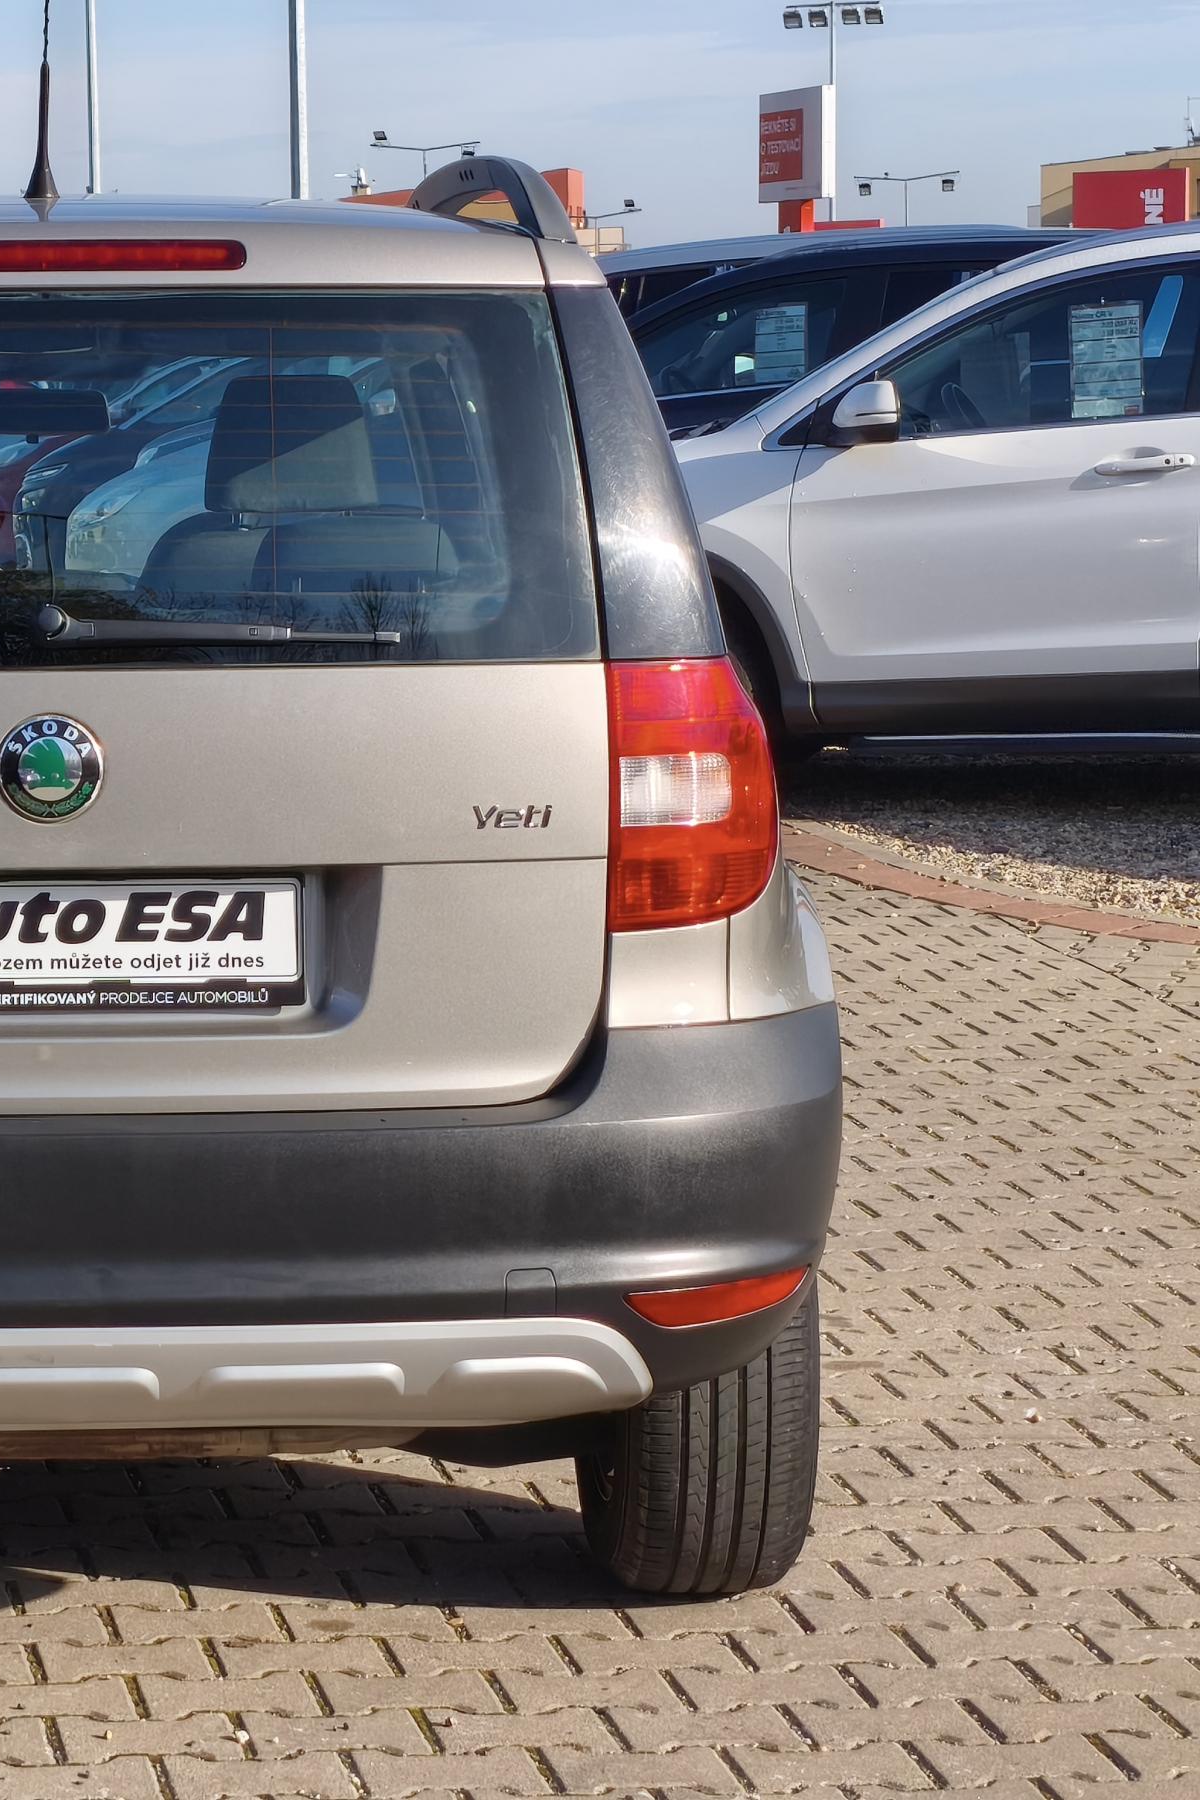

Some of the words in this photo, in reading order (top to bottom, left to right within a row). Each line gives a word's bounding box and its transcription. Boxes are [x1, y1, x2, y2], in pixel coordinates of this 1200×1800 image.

[472, 804, 553, 830] Yeti
[115, 890, 266, 943] ESA
[50, 952, 123, 970] můžete
[130, 953, 181, 972] odjet
[188, 952, 211, 972] již
[218, 952, 265, 968] dnes
[99, 991, 174, 1004] PRODEJCE
[176, 987, 268, 1004] AUTOMOBILŮ
